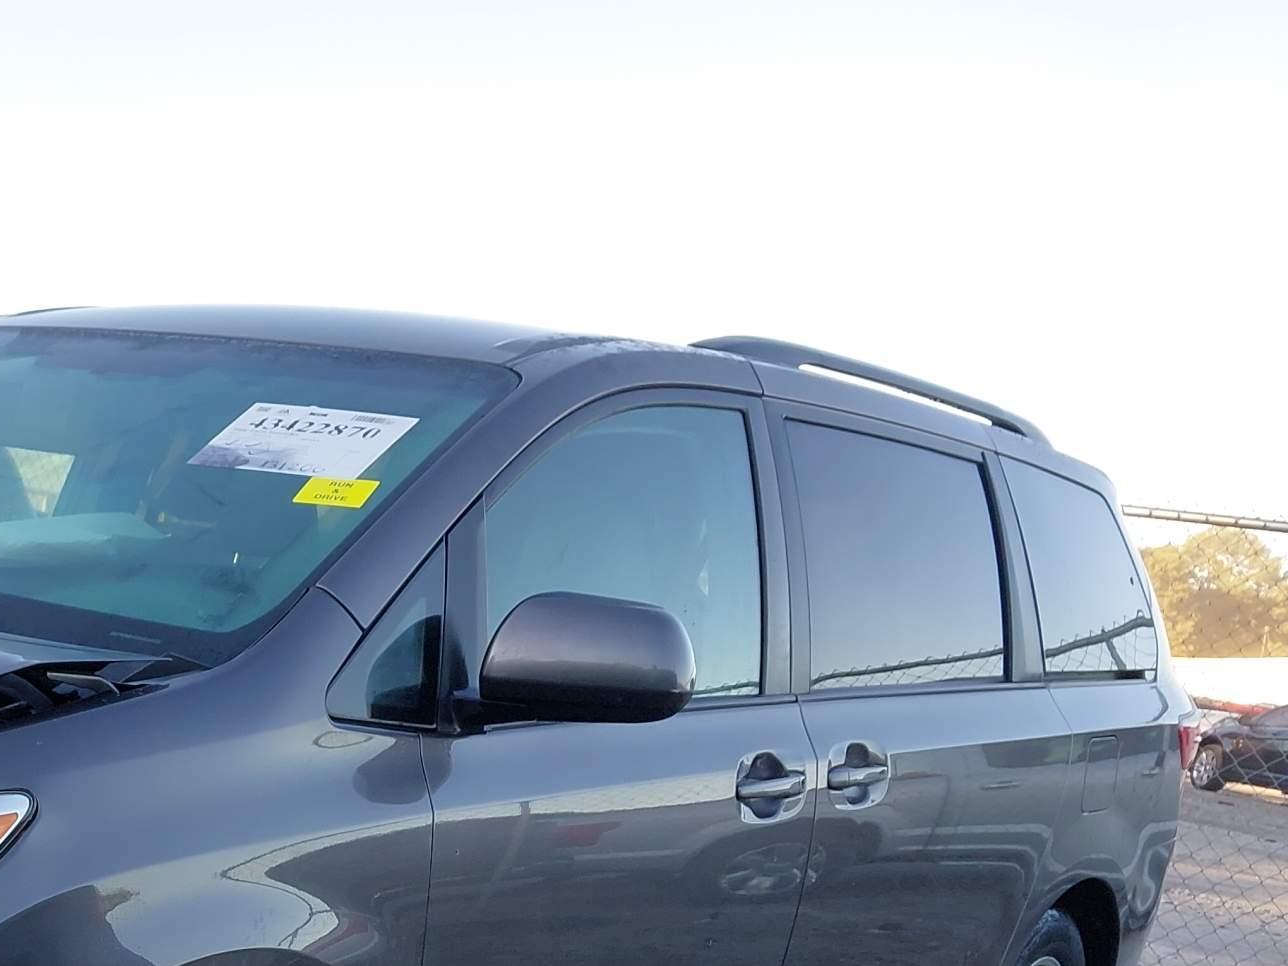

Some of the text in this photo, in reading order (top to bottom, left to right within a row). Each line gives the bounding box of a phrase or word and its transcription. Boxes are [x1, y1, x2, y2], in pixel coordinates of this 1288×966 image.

[249, 415, 382, 440] 43422870
[328, 480, 354, 489] RUN
[313, 493, 348, 502] DRIVE
